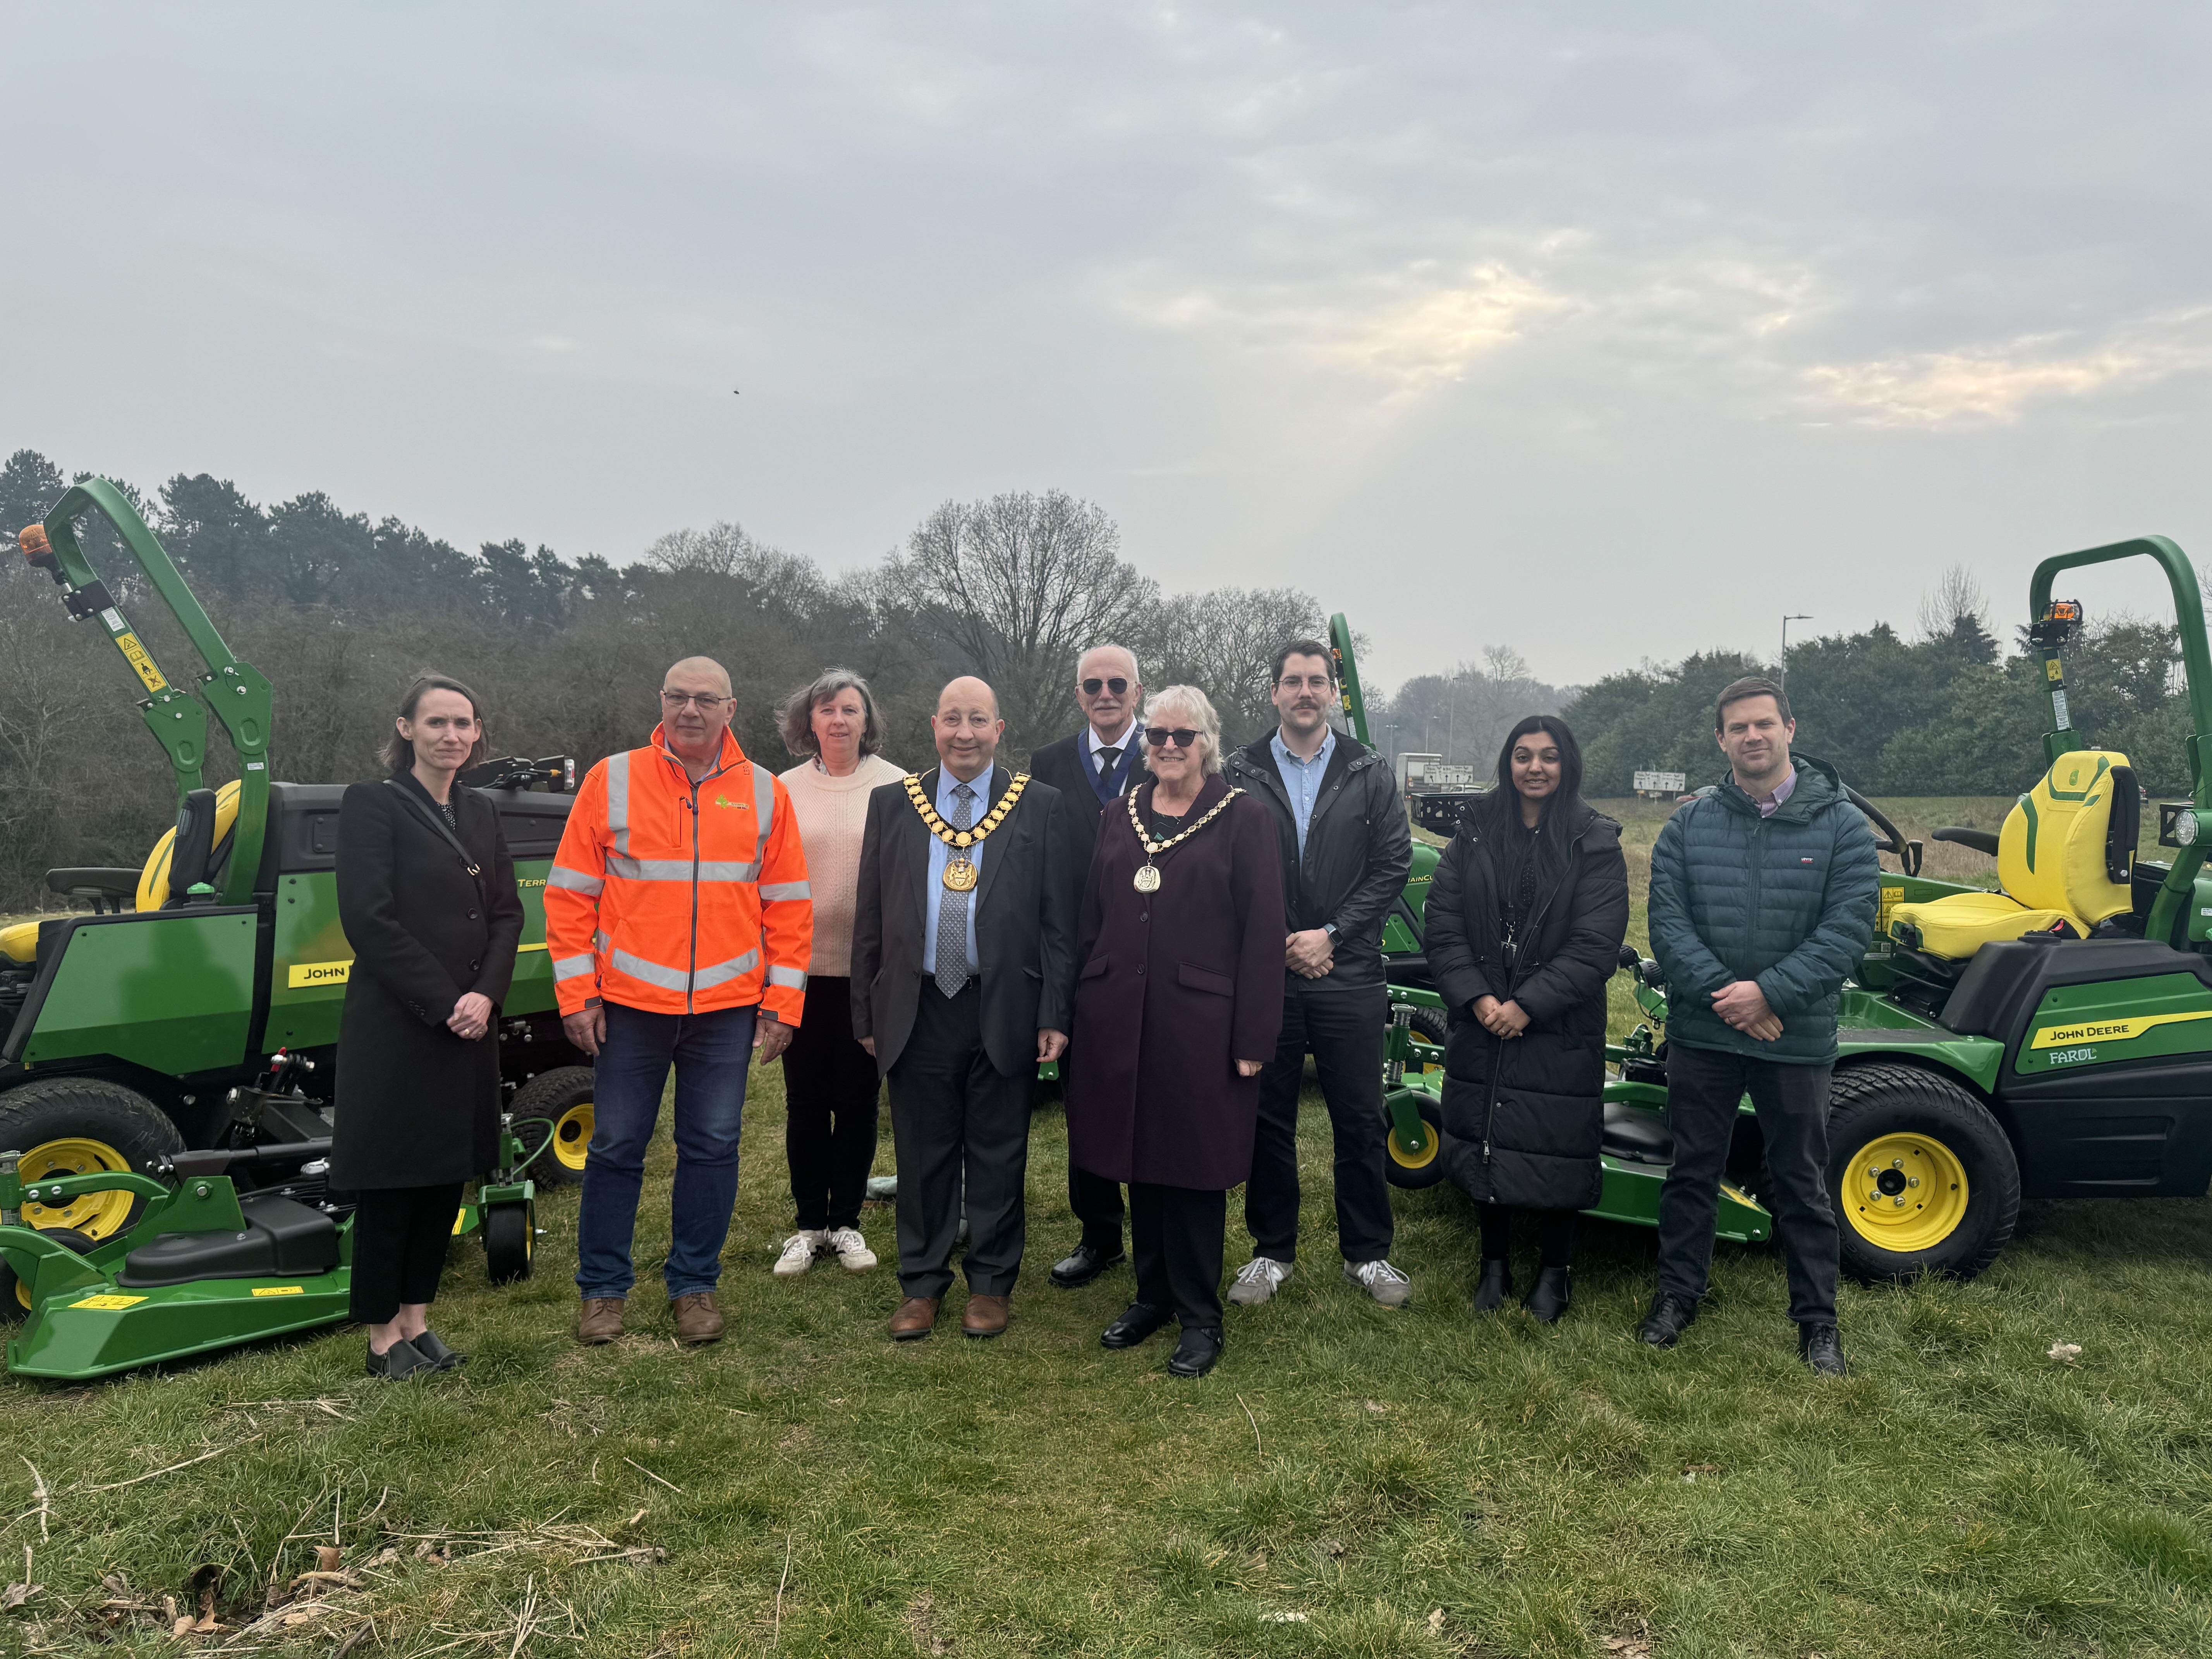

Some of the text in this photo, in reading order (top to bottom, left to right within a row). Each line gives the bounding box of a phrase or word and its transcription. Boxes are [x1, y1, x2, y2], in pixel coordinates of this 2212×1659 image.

[304, 967, 345, 979] JOHN
[2050, 1025, 2130, 1041] JOHN DEERE
[2049, 1048, 2097, 1064] FAROL
